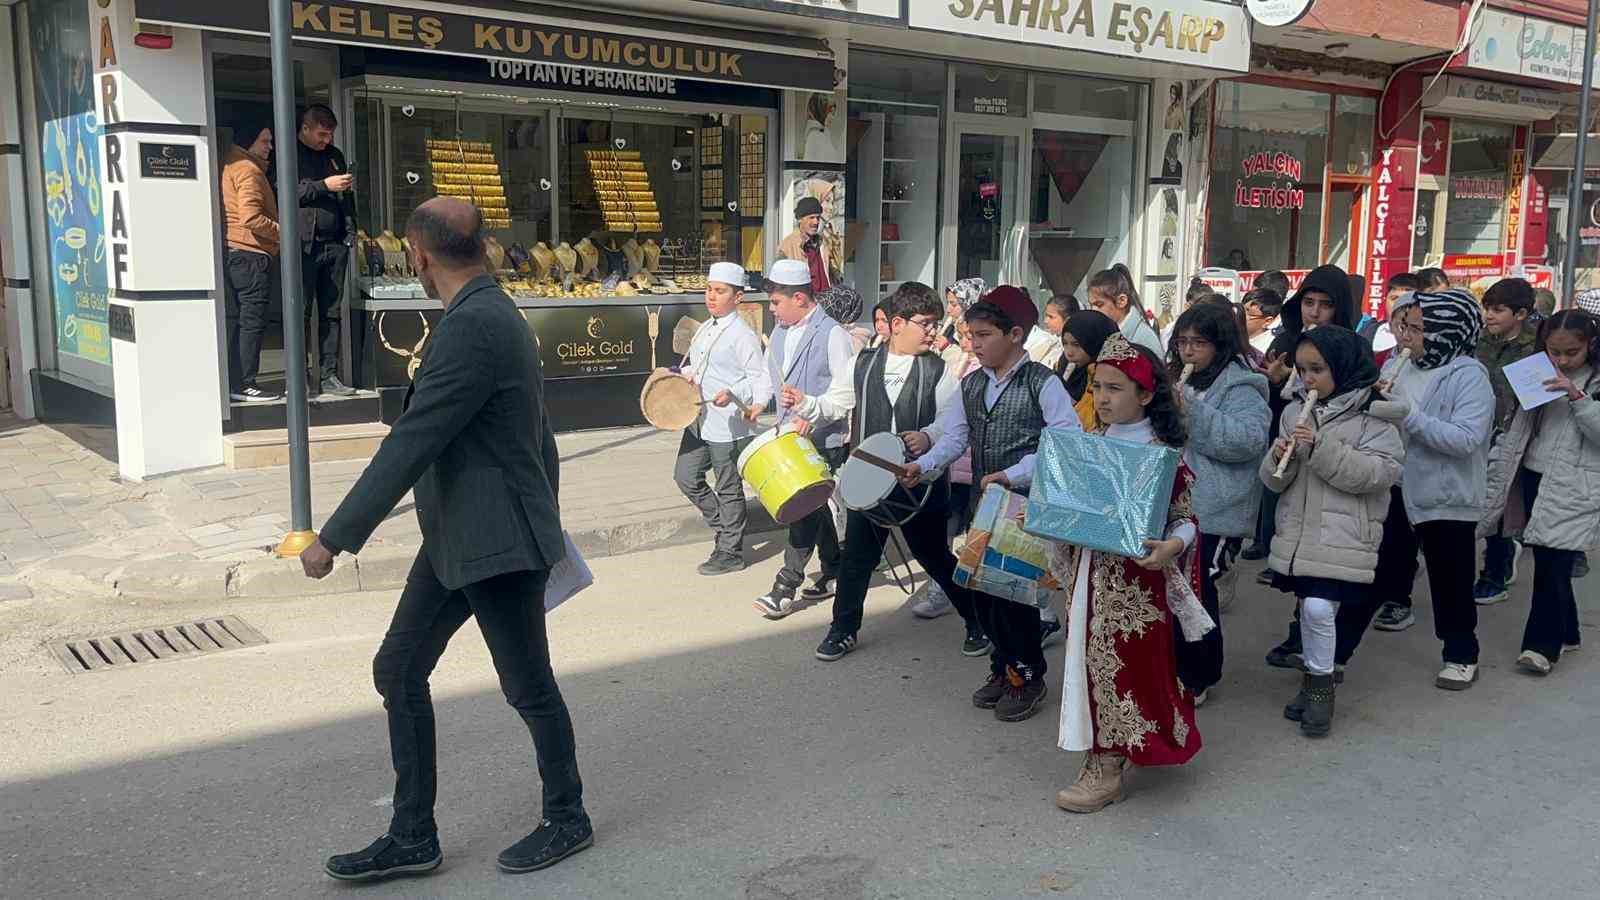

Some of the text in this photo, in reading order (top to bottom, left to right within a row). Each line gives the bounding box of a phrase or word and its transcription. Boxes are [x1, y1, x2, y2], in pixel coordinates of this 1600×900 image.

[291, 0, 744, 78] KELEŞ KUYUMCULUK
[1107, 4, 1226, 53] EŞARP
[486, 58, 677, 95] TOPTAN VE PERAKENDE
[97, 0, 128, 288] ARRAF
[1235, 179, 1304, 215] İLETİŞİM
[1373, 149, 1393, 255] YALÇIN
[557, 340, 634, 360] Çilek Gold
